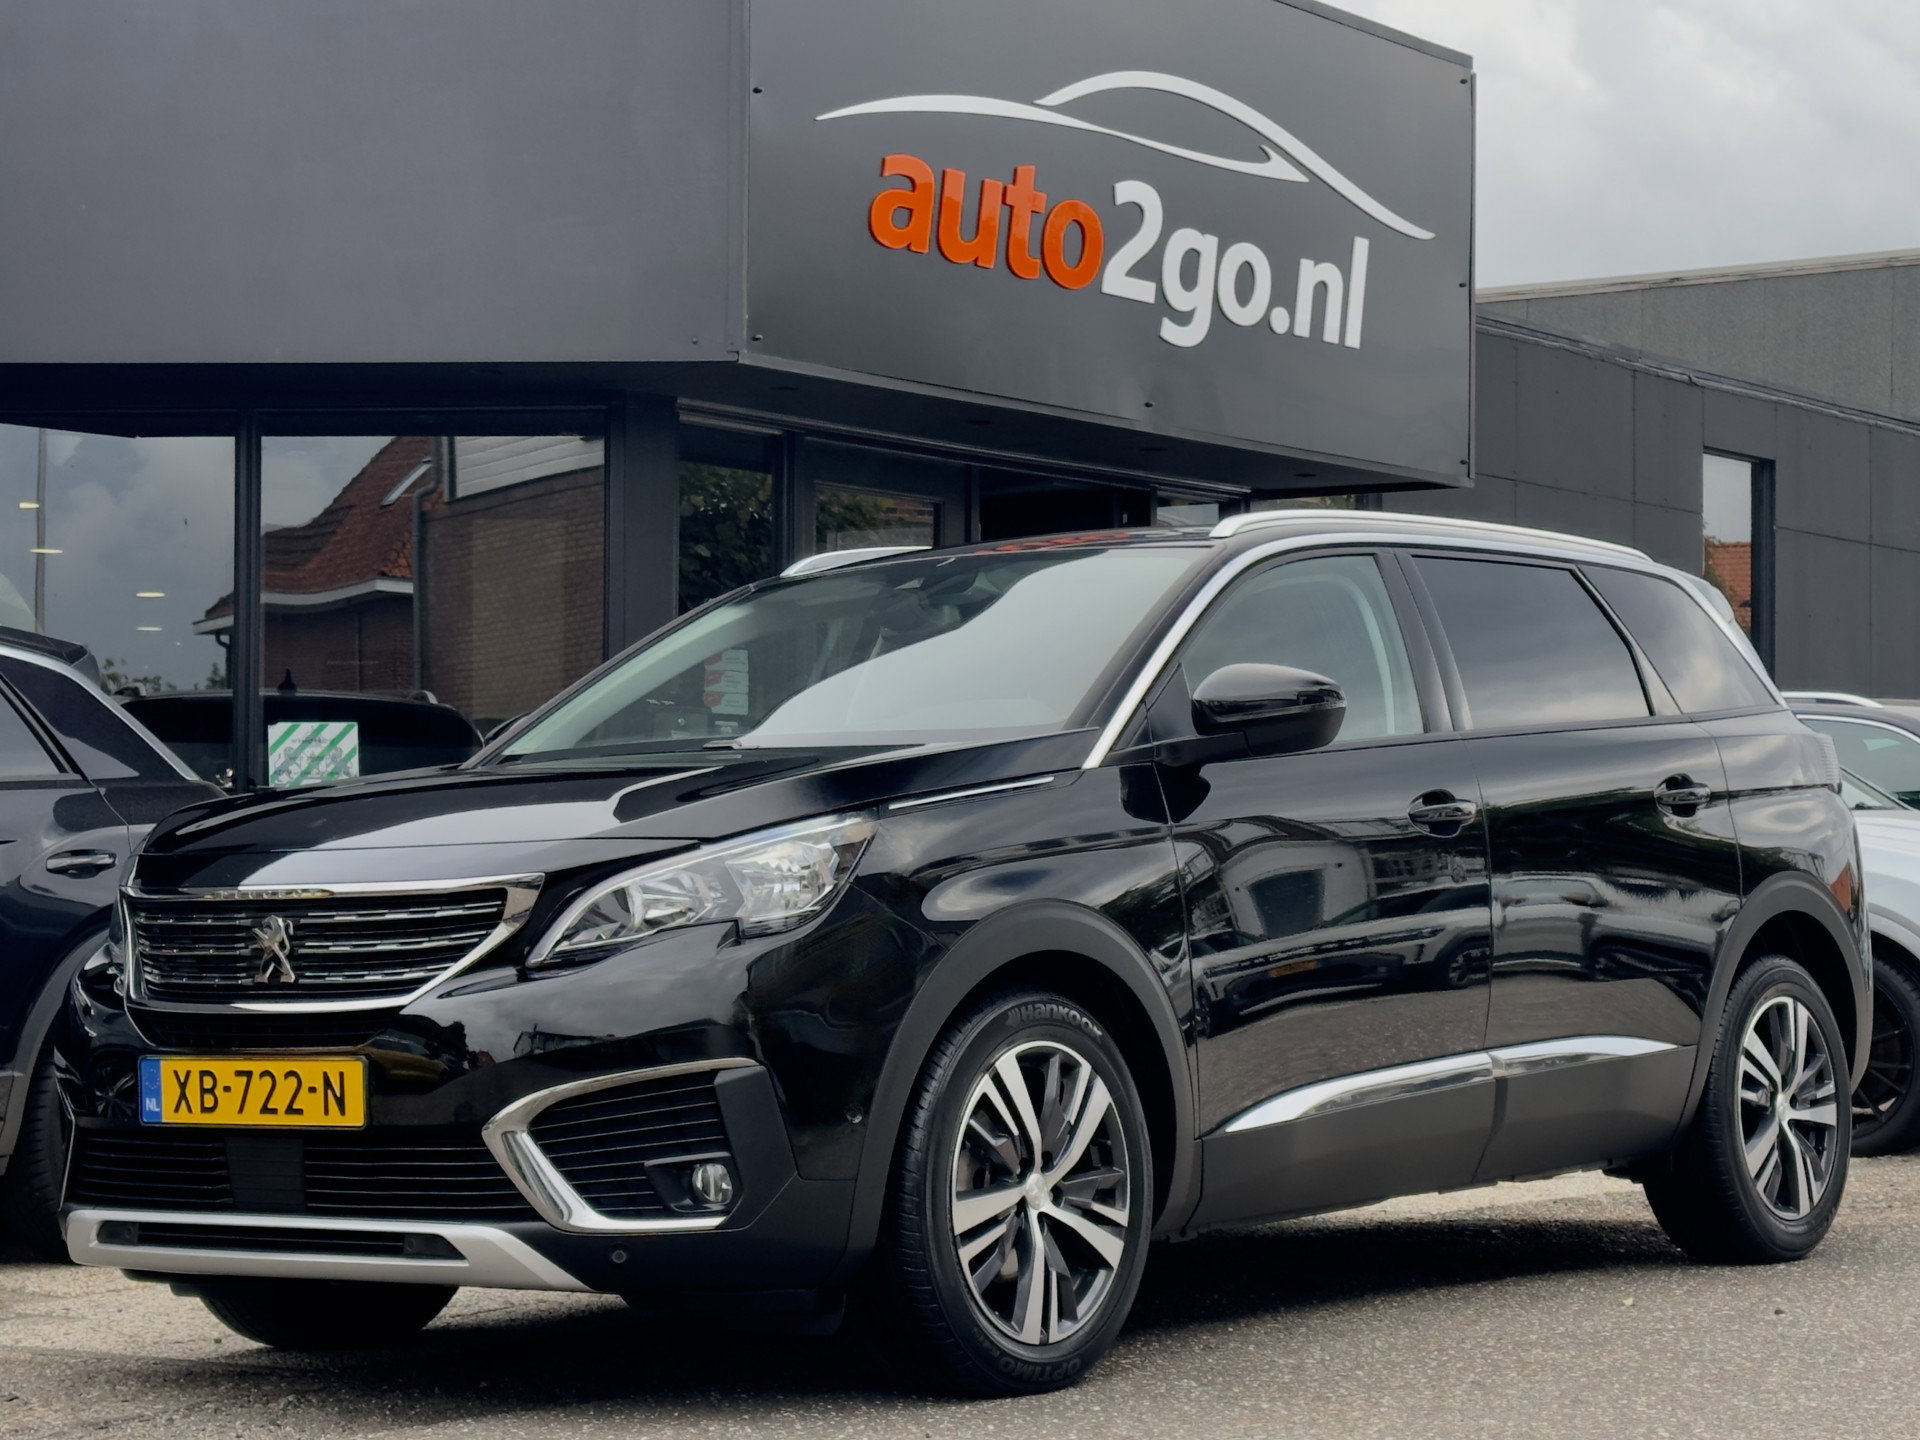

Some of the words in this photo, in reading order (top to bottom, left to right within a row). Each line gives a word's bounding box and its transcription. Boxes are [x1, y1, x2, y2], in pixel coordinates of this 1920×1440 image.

[868, 153, 1370, 349] auto2go.nl
[145, 1098, 161, 1112] NL
[172, 1069, 347, 1117] XB-722-N
